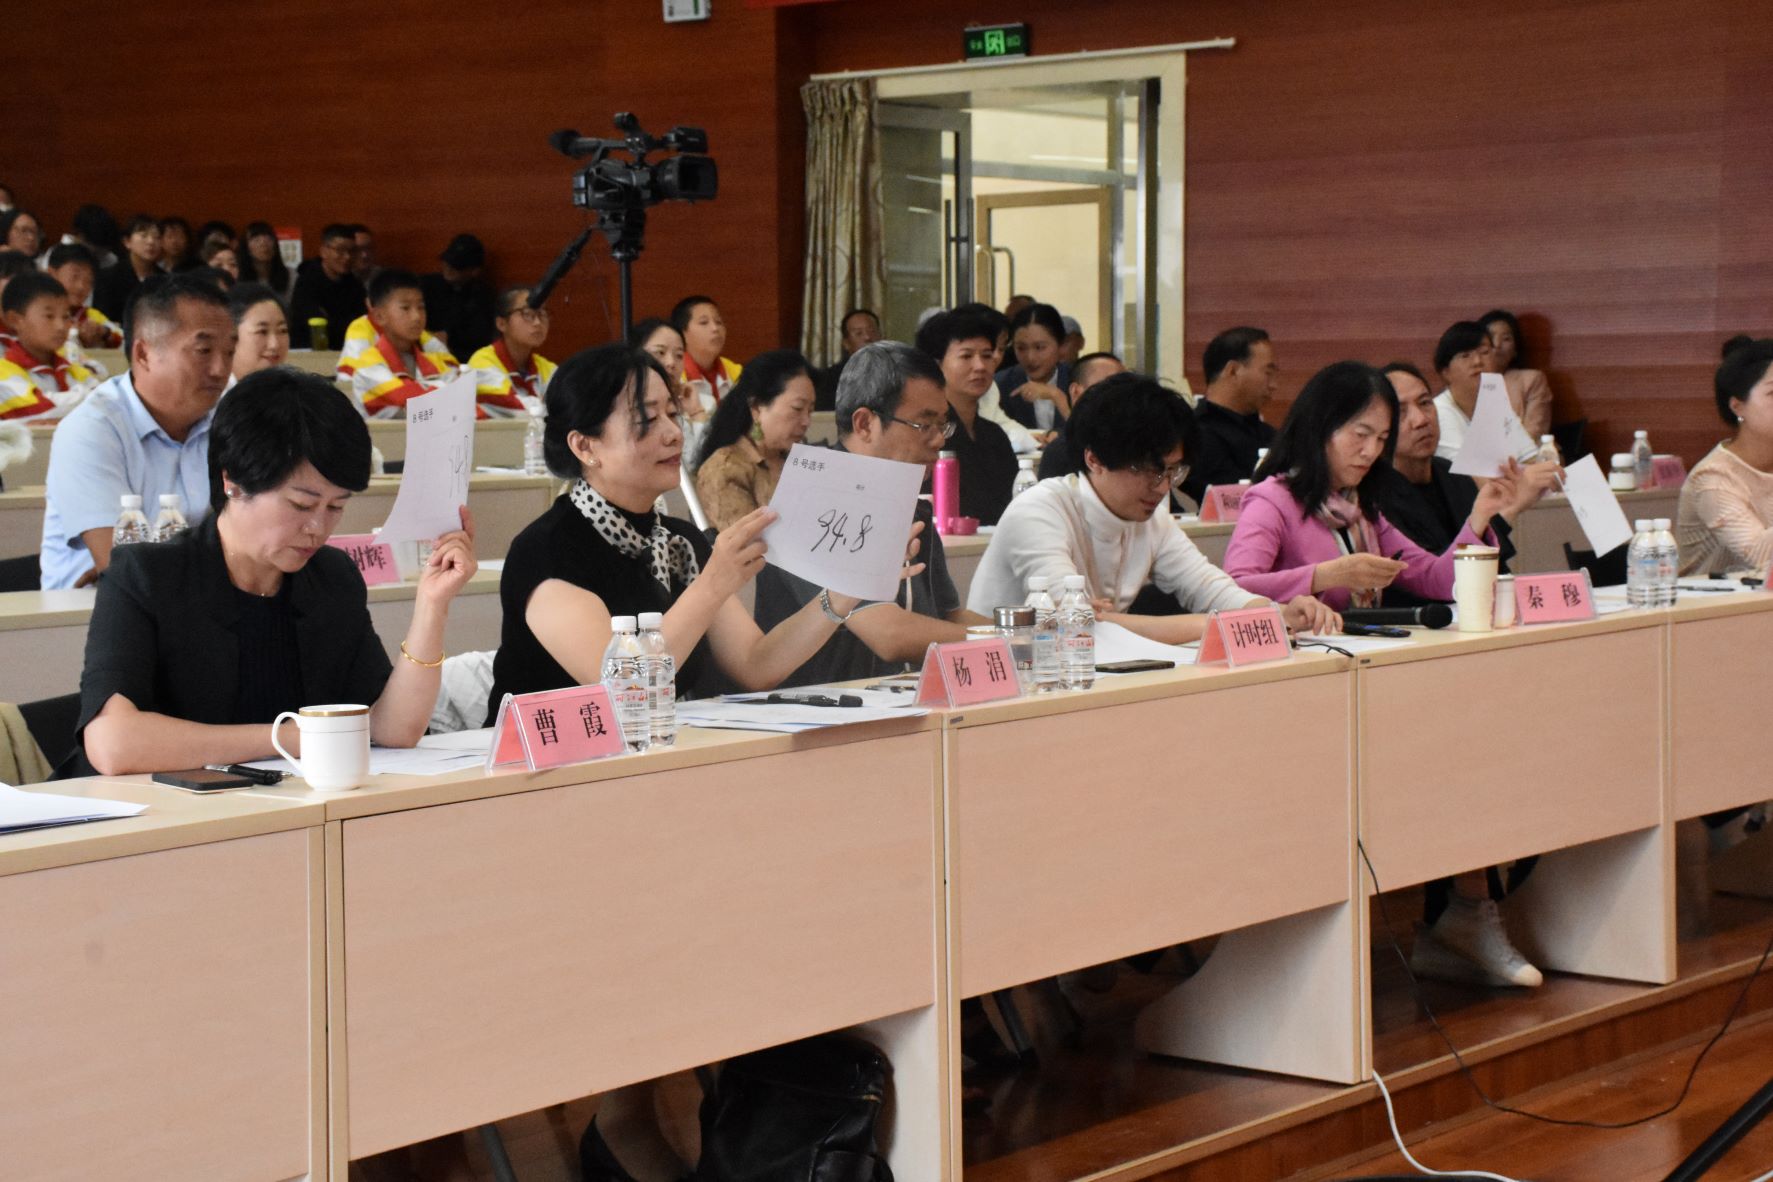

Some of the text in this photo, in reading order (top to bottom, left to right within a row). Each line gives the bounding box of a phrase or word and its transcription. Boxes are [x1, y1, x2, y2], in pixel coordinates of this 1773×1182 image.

[810, 509, 873, 553] 94.8
[1230, 618, 1279, 648] 计时组
[532, 701, 608, 746] 曹霞
